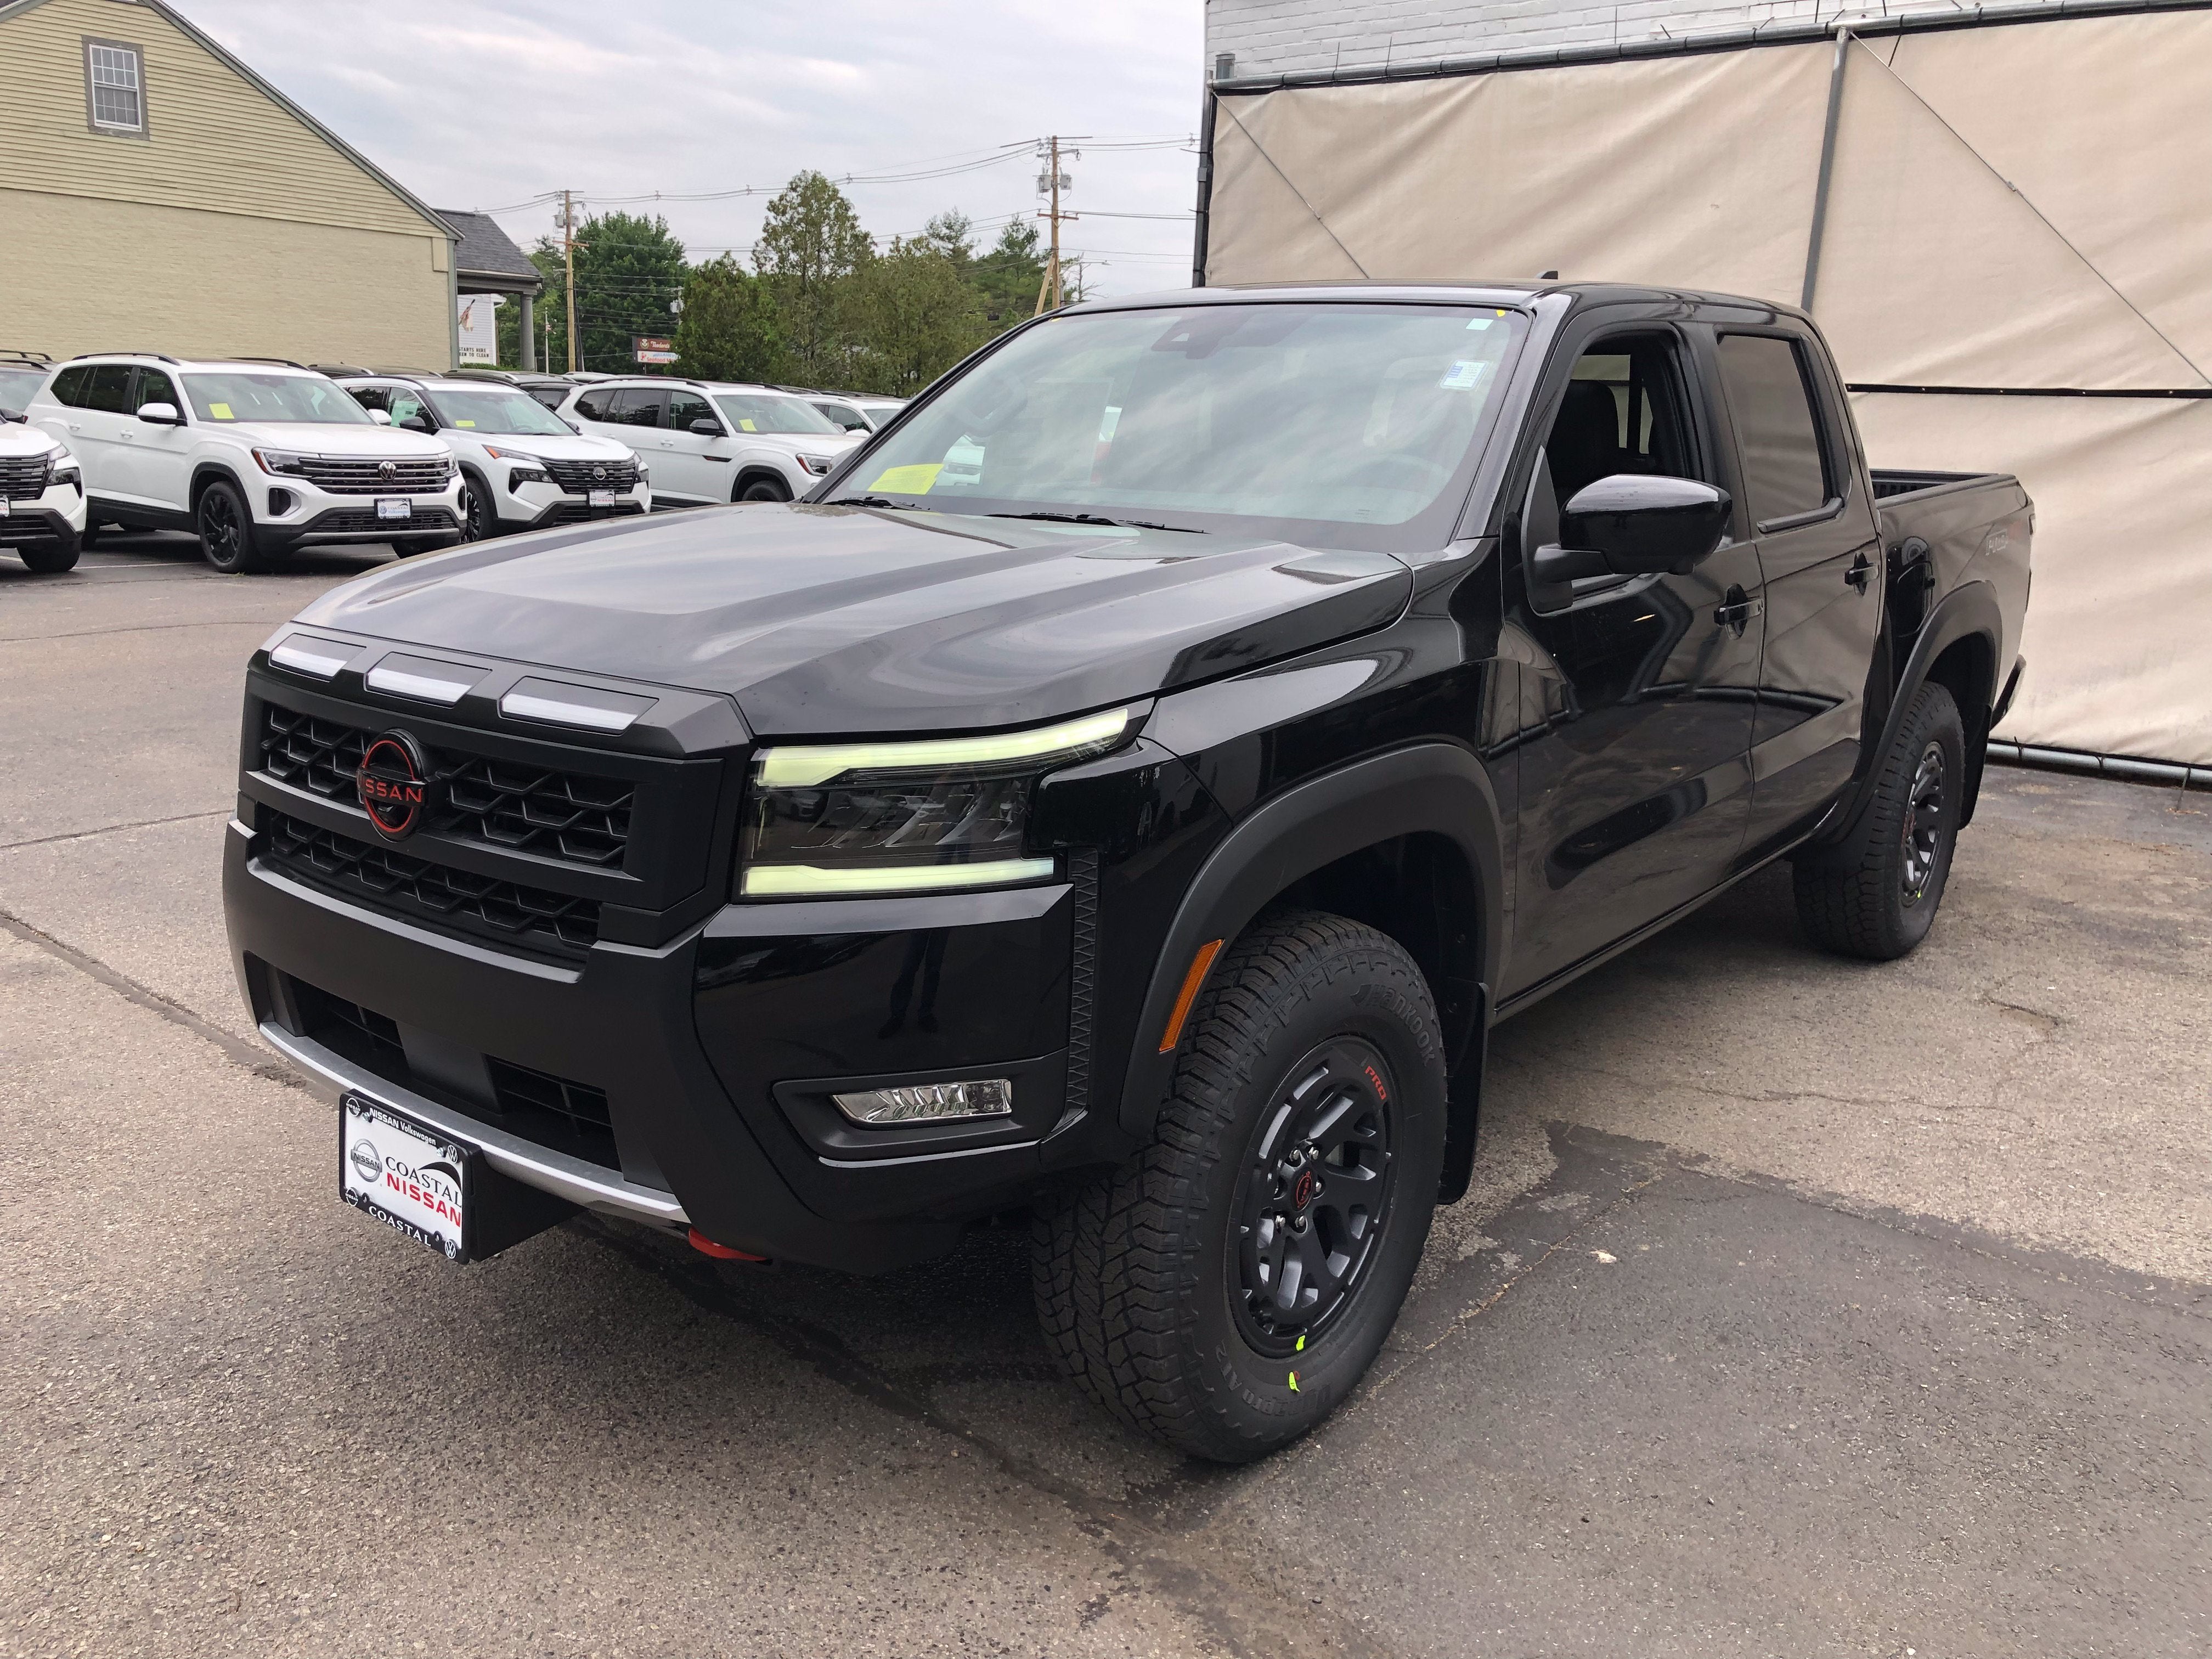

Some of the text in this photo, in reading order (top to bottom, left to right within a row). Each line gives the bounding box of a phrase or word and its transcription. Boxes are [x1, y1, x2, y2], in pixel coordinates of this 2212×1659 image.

[1365, 1065, 1386, 1099] PRO
[369, 1107, 436, 1146] NISSAN Volkswagen
[353, 1152, 380, 1169] NISSAN
[385, 1156, 462, 1208] COASTAL
[386, 1172, 461, 1228] NISSAN
[369, 1205, 432, 1247] COASTAL
